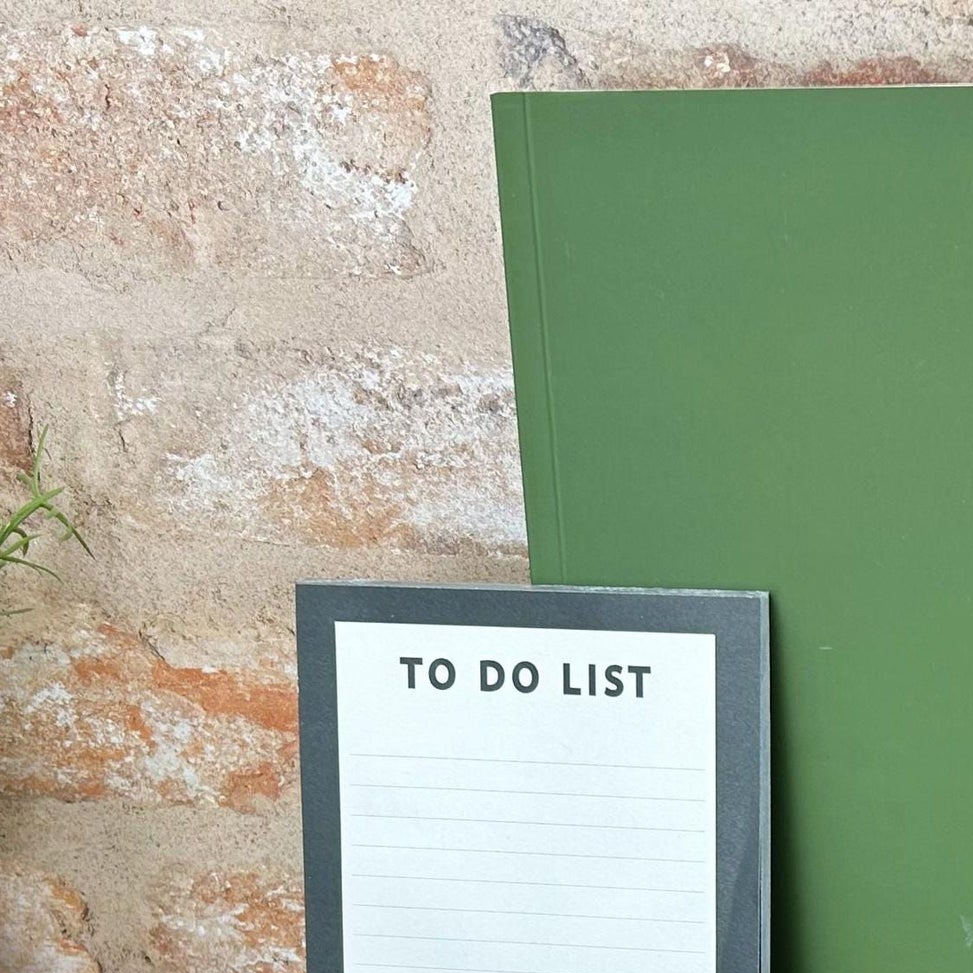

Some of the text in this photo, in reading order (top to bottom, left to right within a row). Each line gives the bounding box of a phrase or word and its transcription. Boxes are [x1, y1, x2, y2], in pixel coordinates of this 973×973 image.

[400, 656, 652, 699] TO DO LIST
